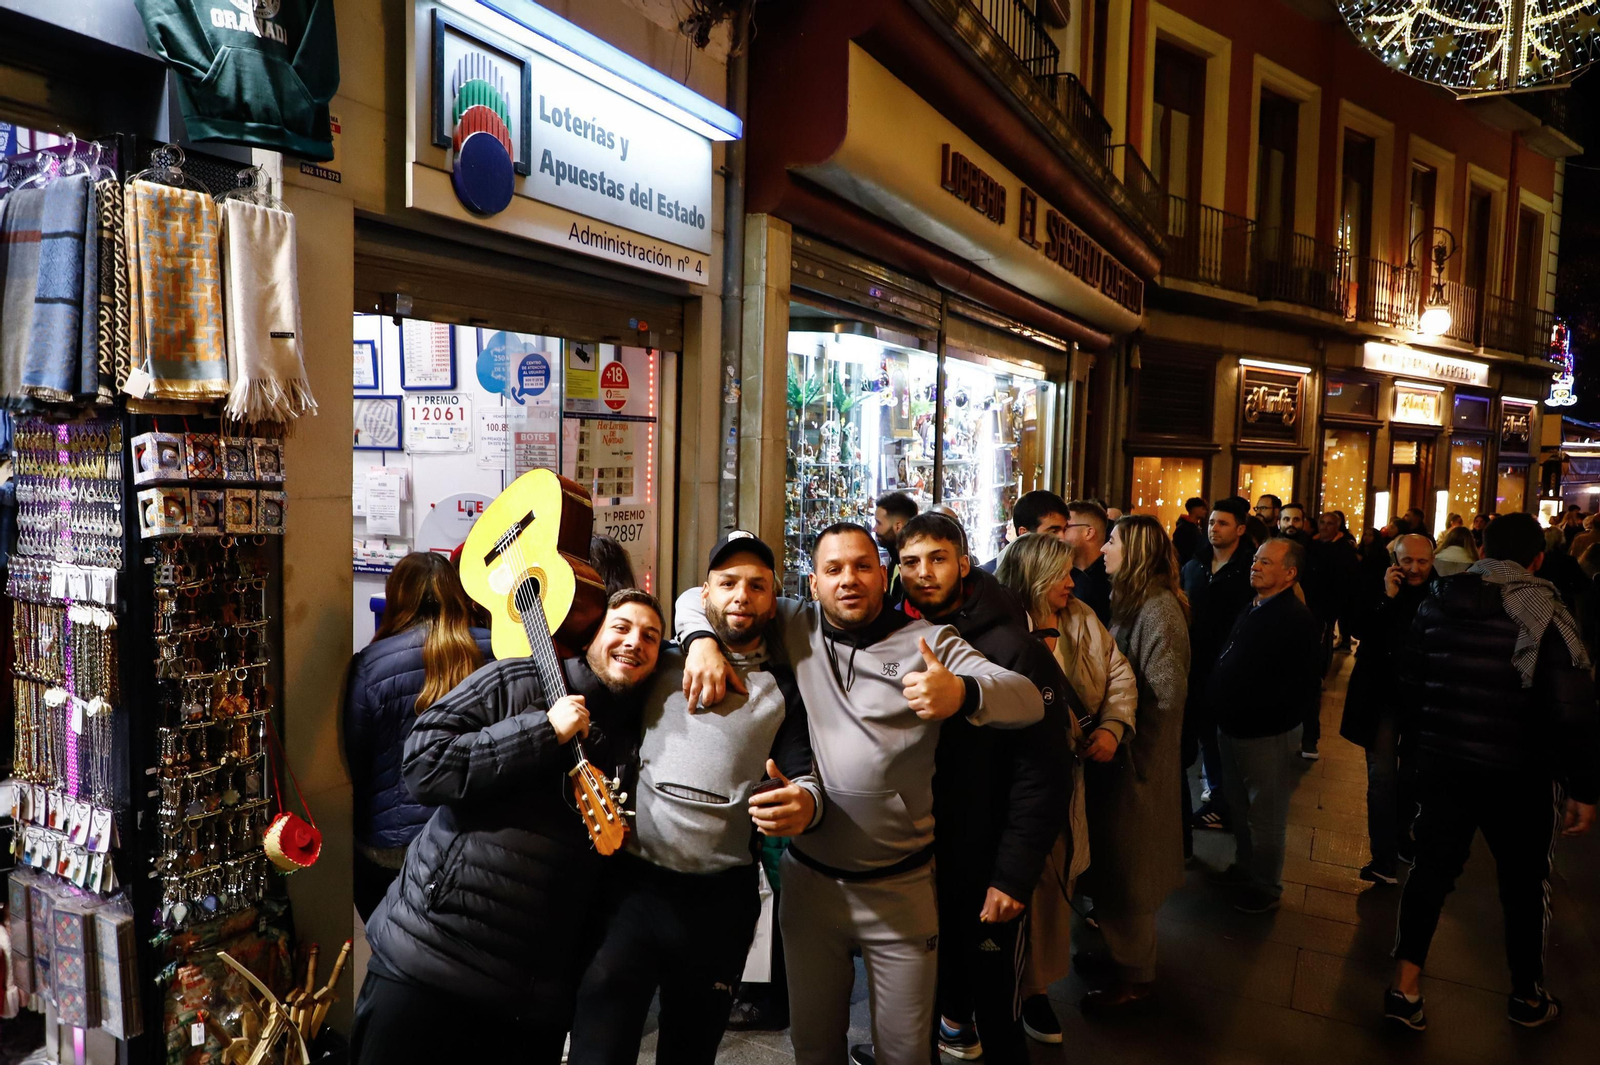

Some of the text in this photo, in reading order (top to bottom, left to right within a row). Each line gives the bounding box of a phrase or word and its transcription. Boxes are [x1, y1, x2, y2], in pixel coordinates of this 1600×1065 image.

[539, 95, 630, 162] Loterías y
[302, 164, 340, 182] 902 114 573
[540, 148, 706, 230] Apuestas del Estado
[1019, 187, 1042, 250] EL
[568, 222, 672, 268] Administración
[696, 260, 702, 276] 4
[606, 367, 622, 382] +18
[425, 396, 459, 405] PREMIO
[412, 407, 464, 420] 12061
[613, 510, 645, 521] PREMIO
[605, 524, 643, 542] 72897
